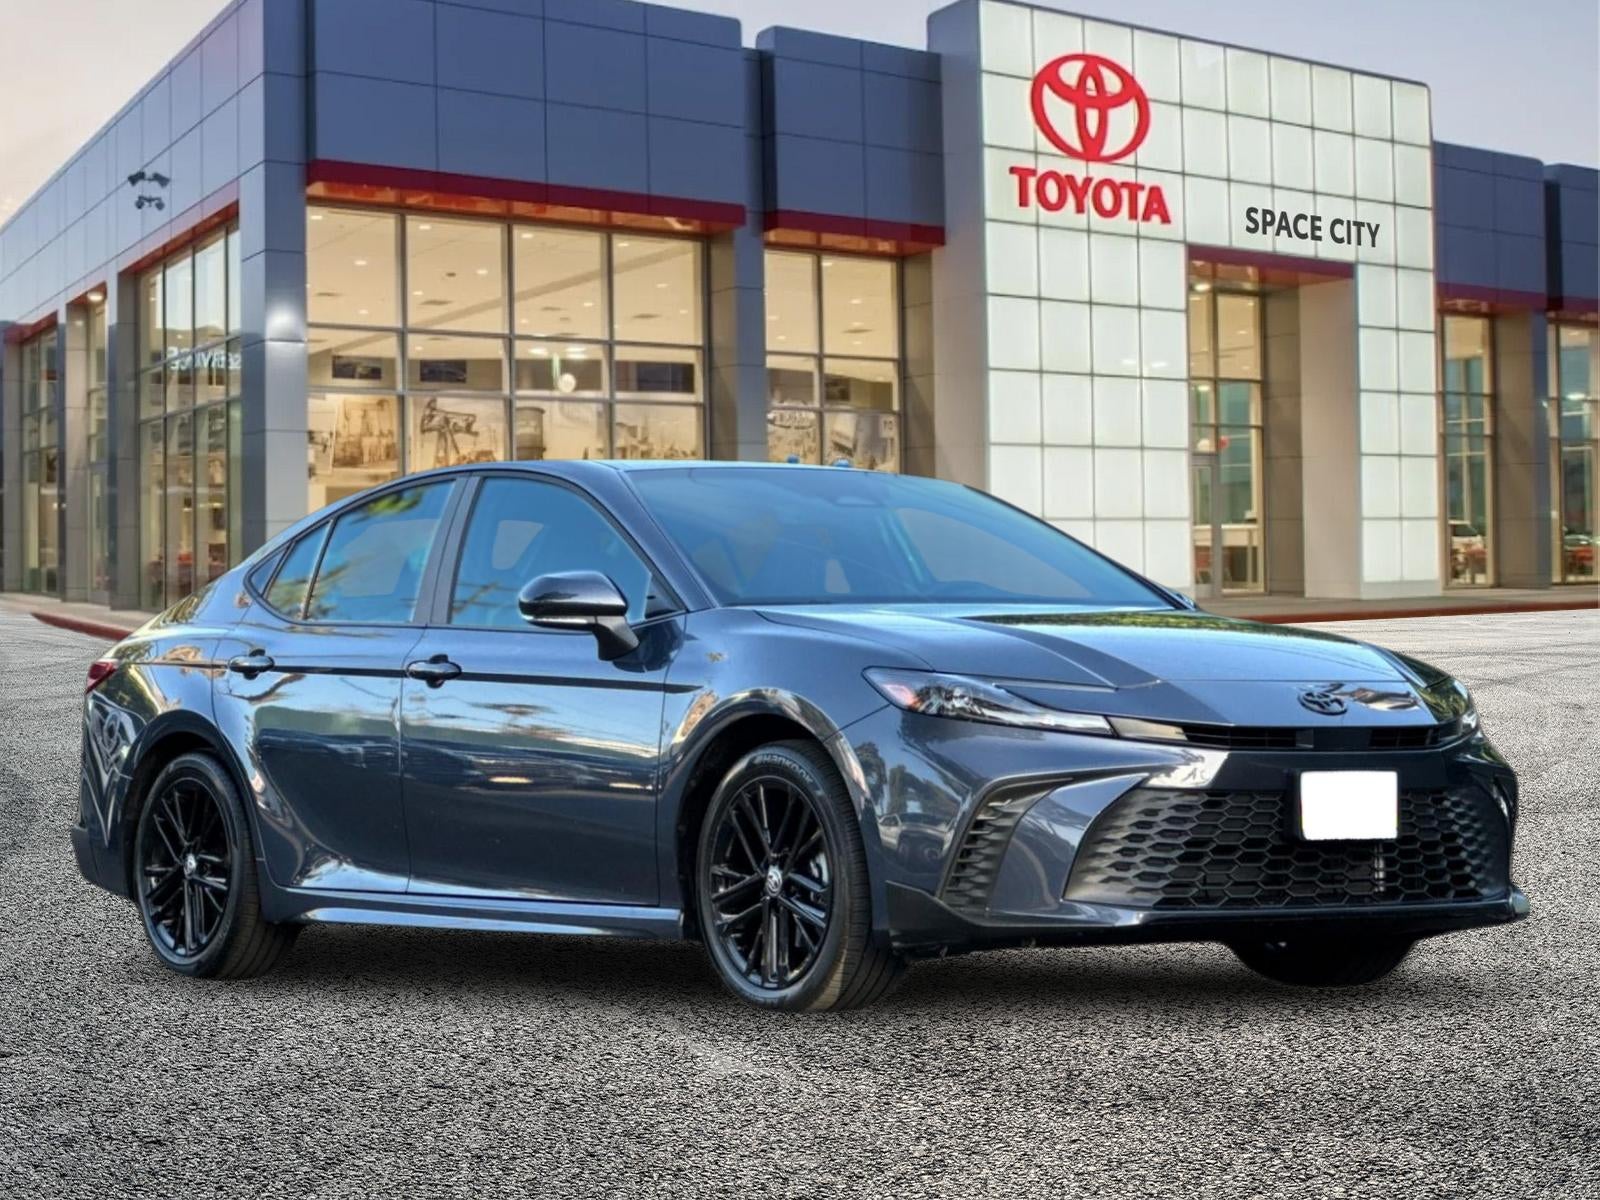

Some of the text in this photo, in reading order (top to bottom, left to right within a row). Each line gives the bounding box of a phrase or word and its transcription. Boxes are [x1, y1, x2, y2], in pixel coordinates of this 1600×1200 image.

[1009, 166, 1171, 225] TOYOTA
[1245, 206, 1381, 248] SPACE CITY
